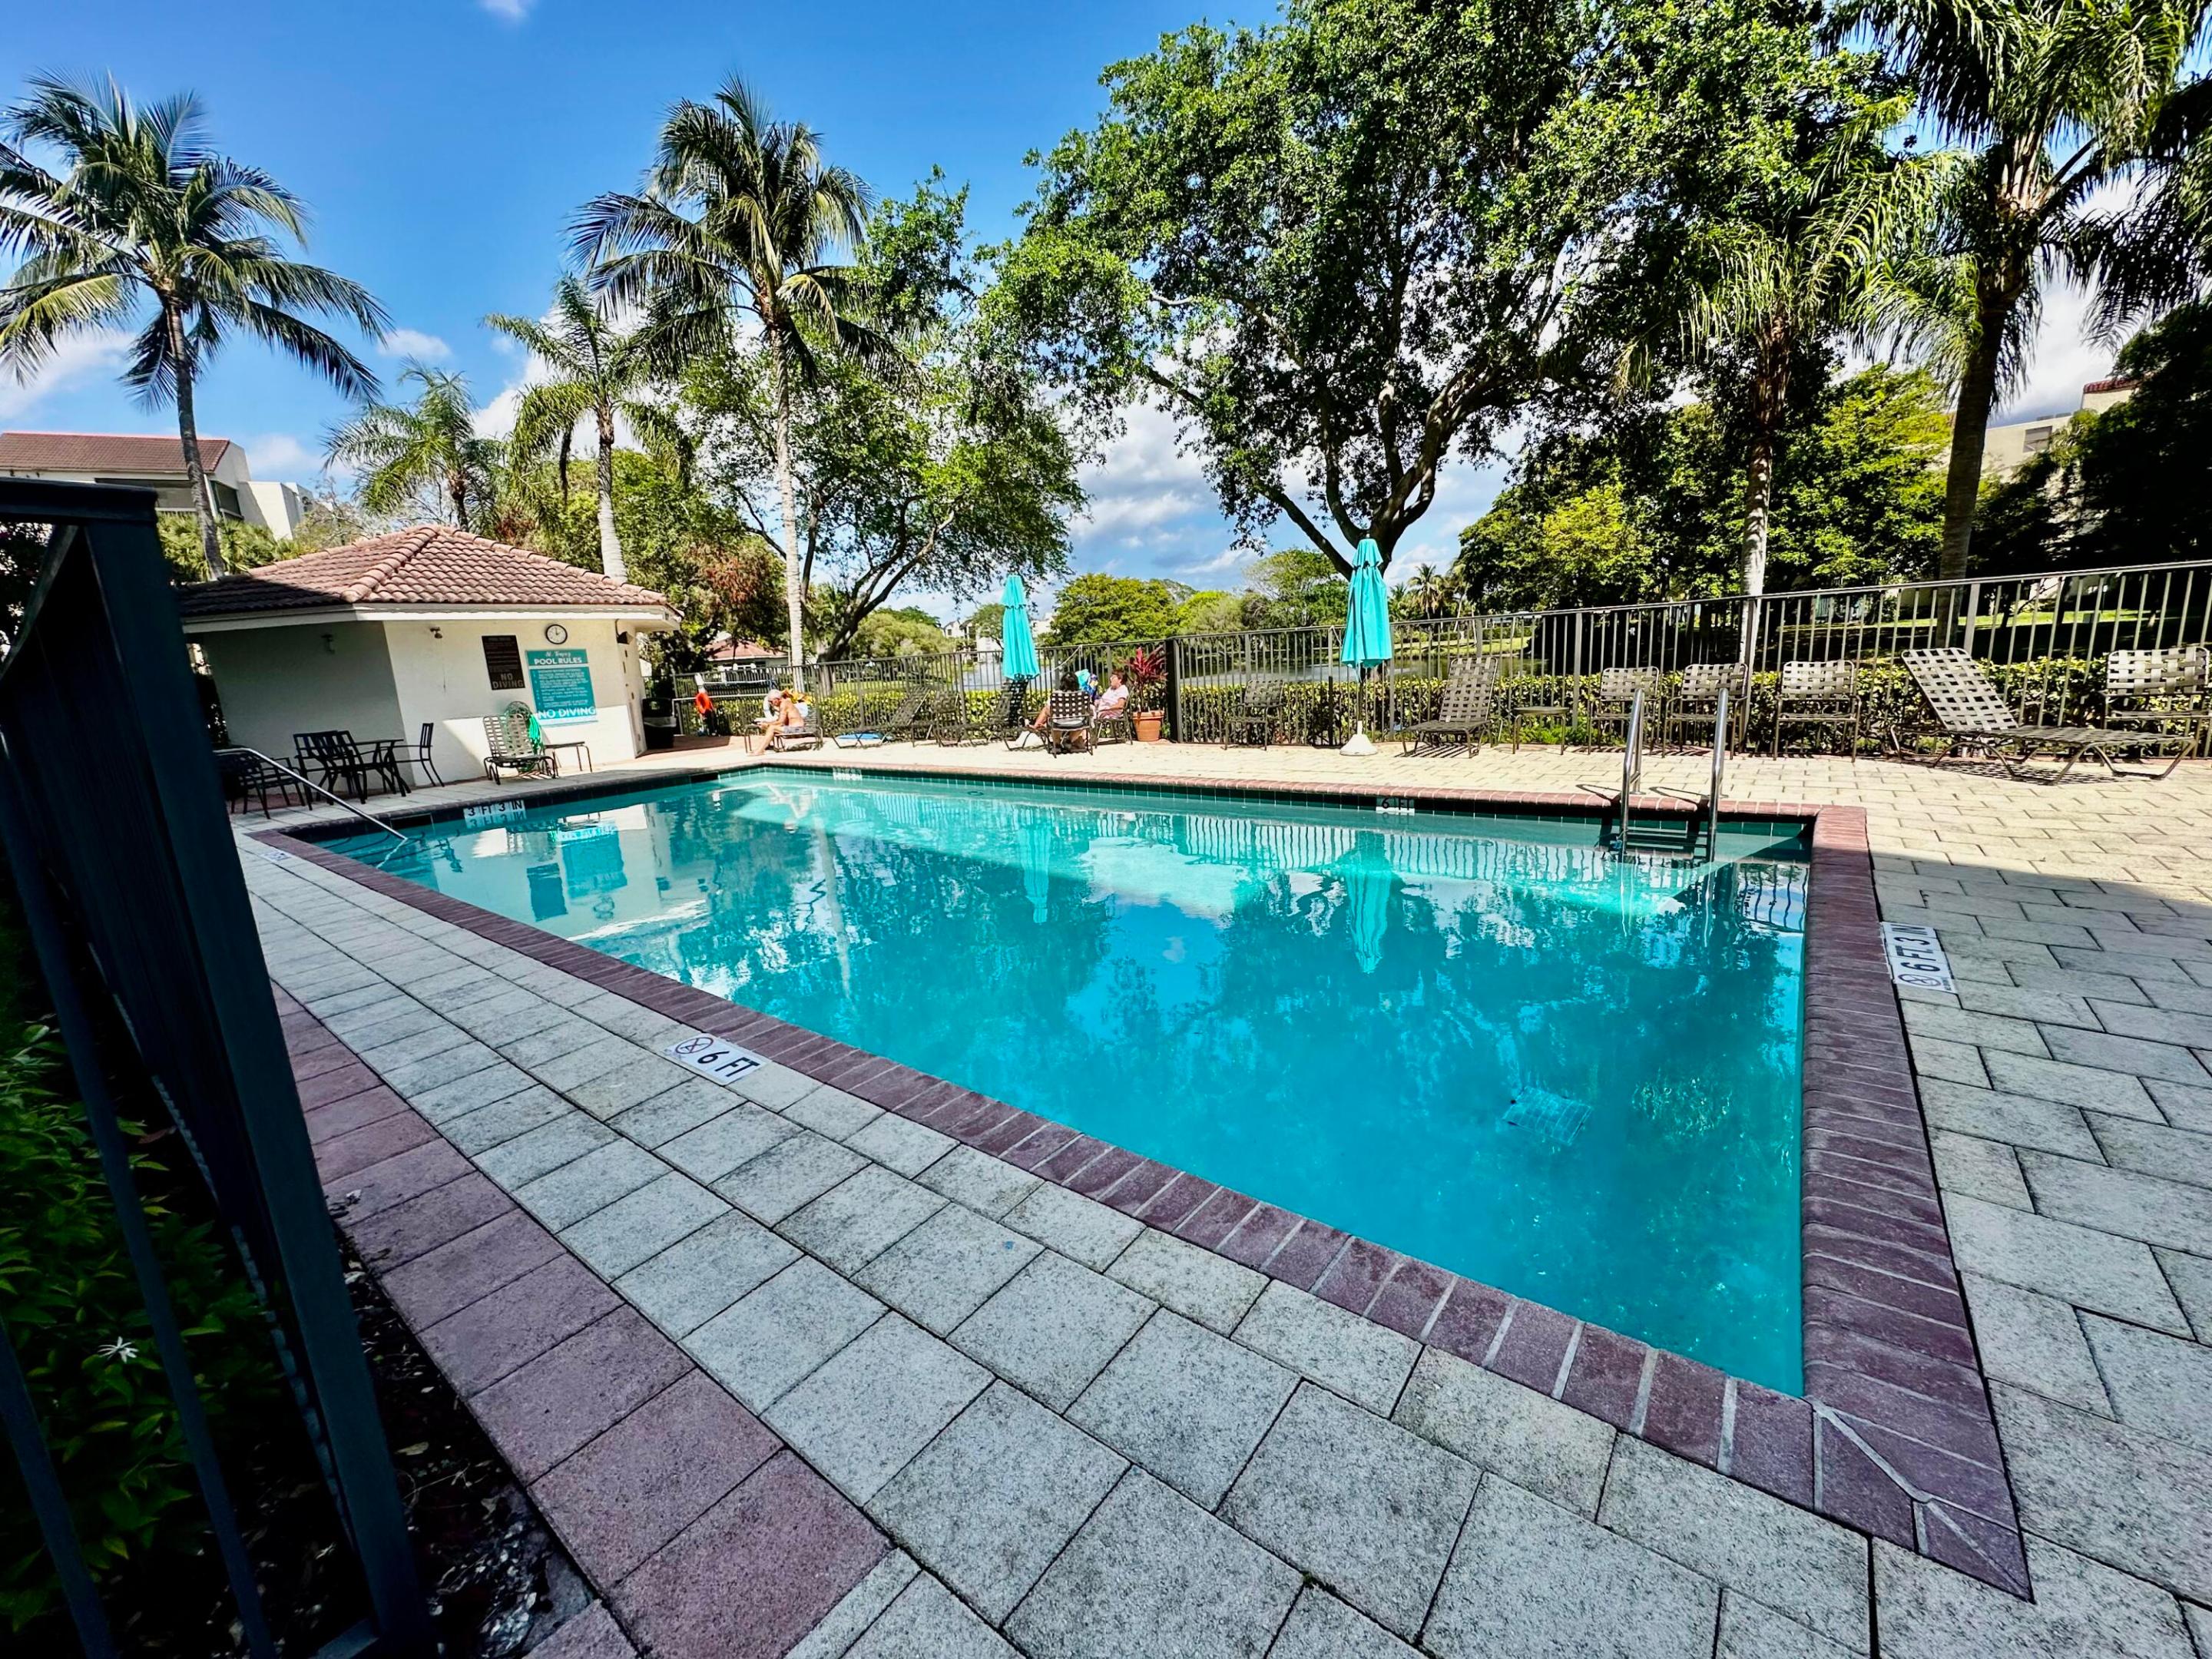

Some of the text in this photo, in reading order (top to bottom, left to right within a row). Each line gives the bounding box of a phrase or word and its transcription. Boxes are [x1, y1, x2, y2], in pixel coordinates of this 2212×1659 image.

[492, 680, 524, 689] DIVING
[538, 706, 596, 719] NO DIVING
[468, 806, 475, 816] 3
[498, 802, 506, 812] 3
[511, 799, 523, 810] IN
[1382, 797, 1412, 810] 6 FT
[1890, 924, 1929, 935] IN
[1893, 936, 1930, 945] 3
[1900, 962, 1940, 972] 6
[697, 1050, 730, 1064] 6
[714, 1057, 761, 1077] FT
